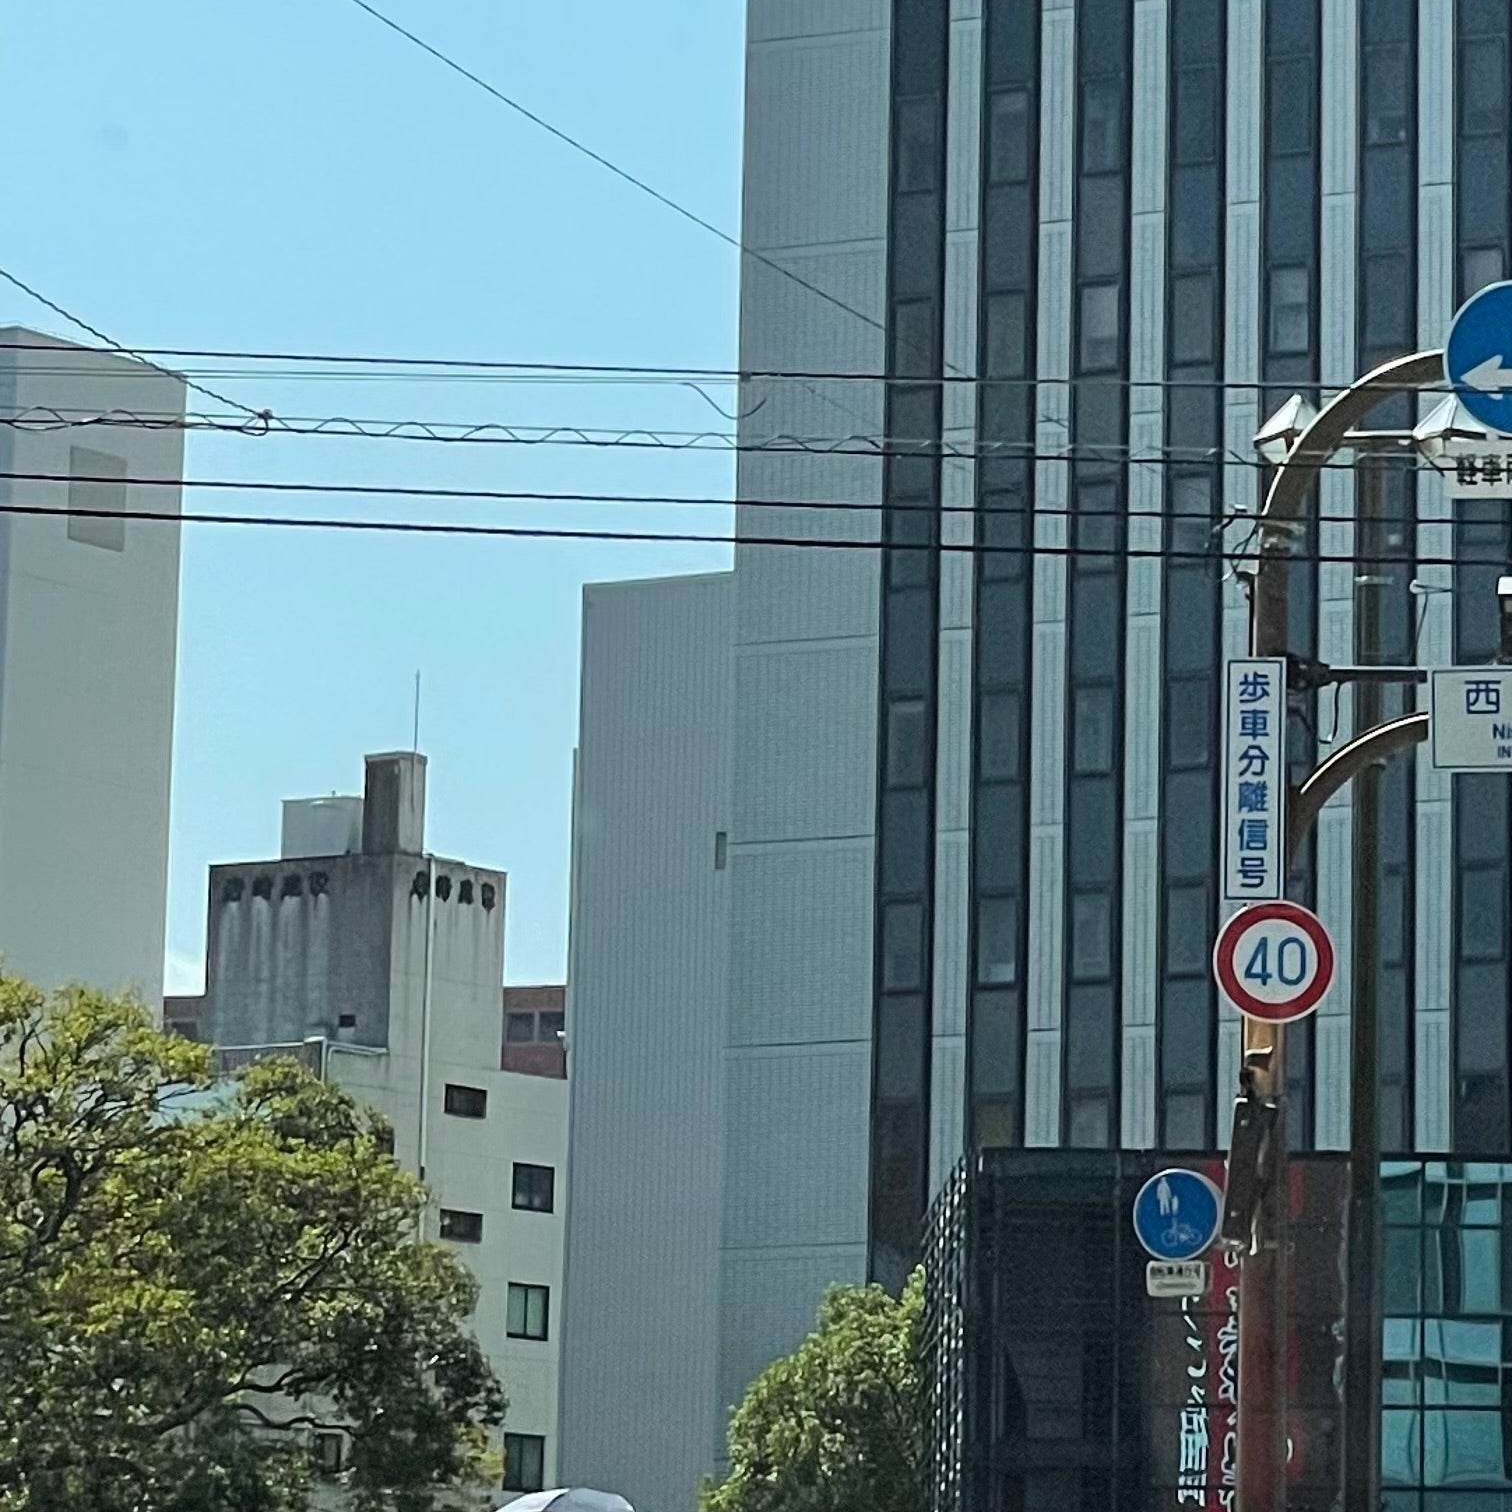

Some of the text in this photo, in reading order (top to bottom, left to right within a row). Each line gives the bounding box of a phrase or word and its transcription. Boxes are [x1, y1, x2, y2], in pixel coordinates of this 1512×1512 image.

[1237, 670, 1271, 889] 歩車分離信号
[1243, 935, 1308, 988] 40
